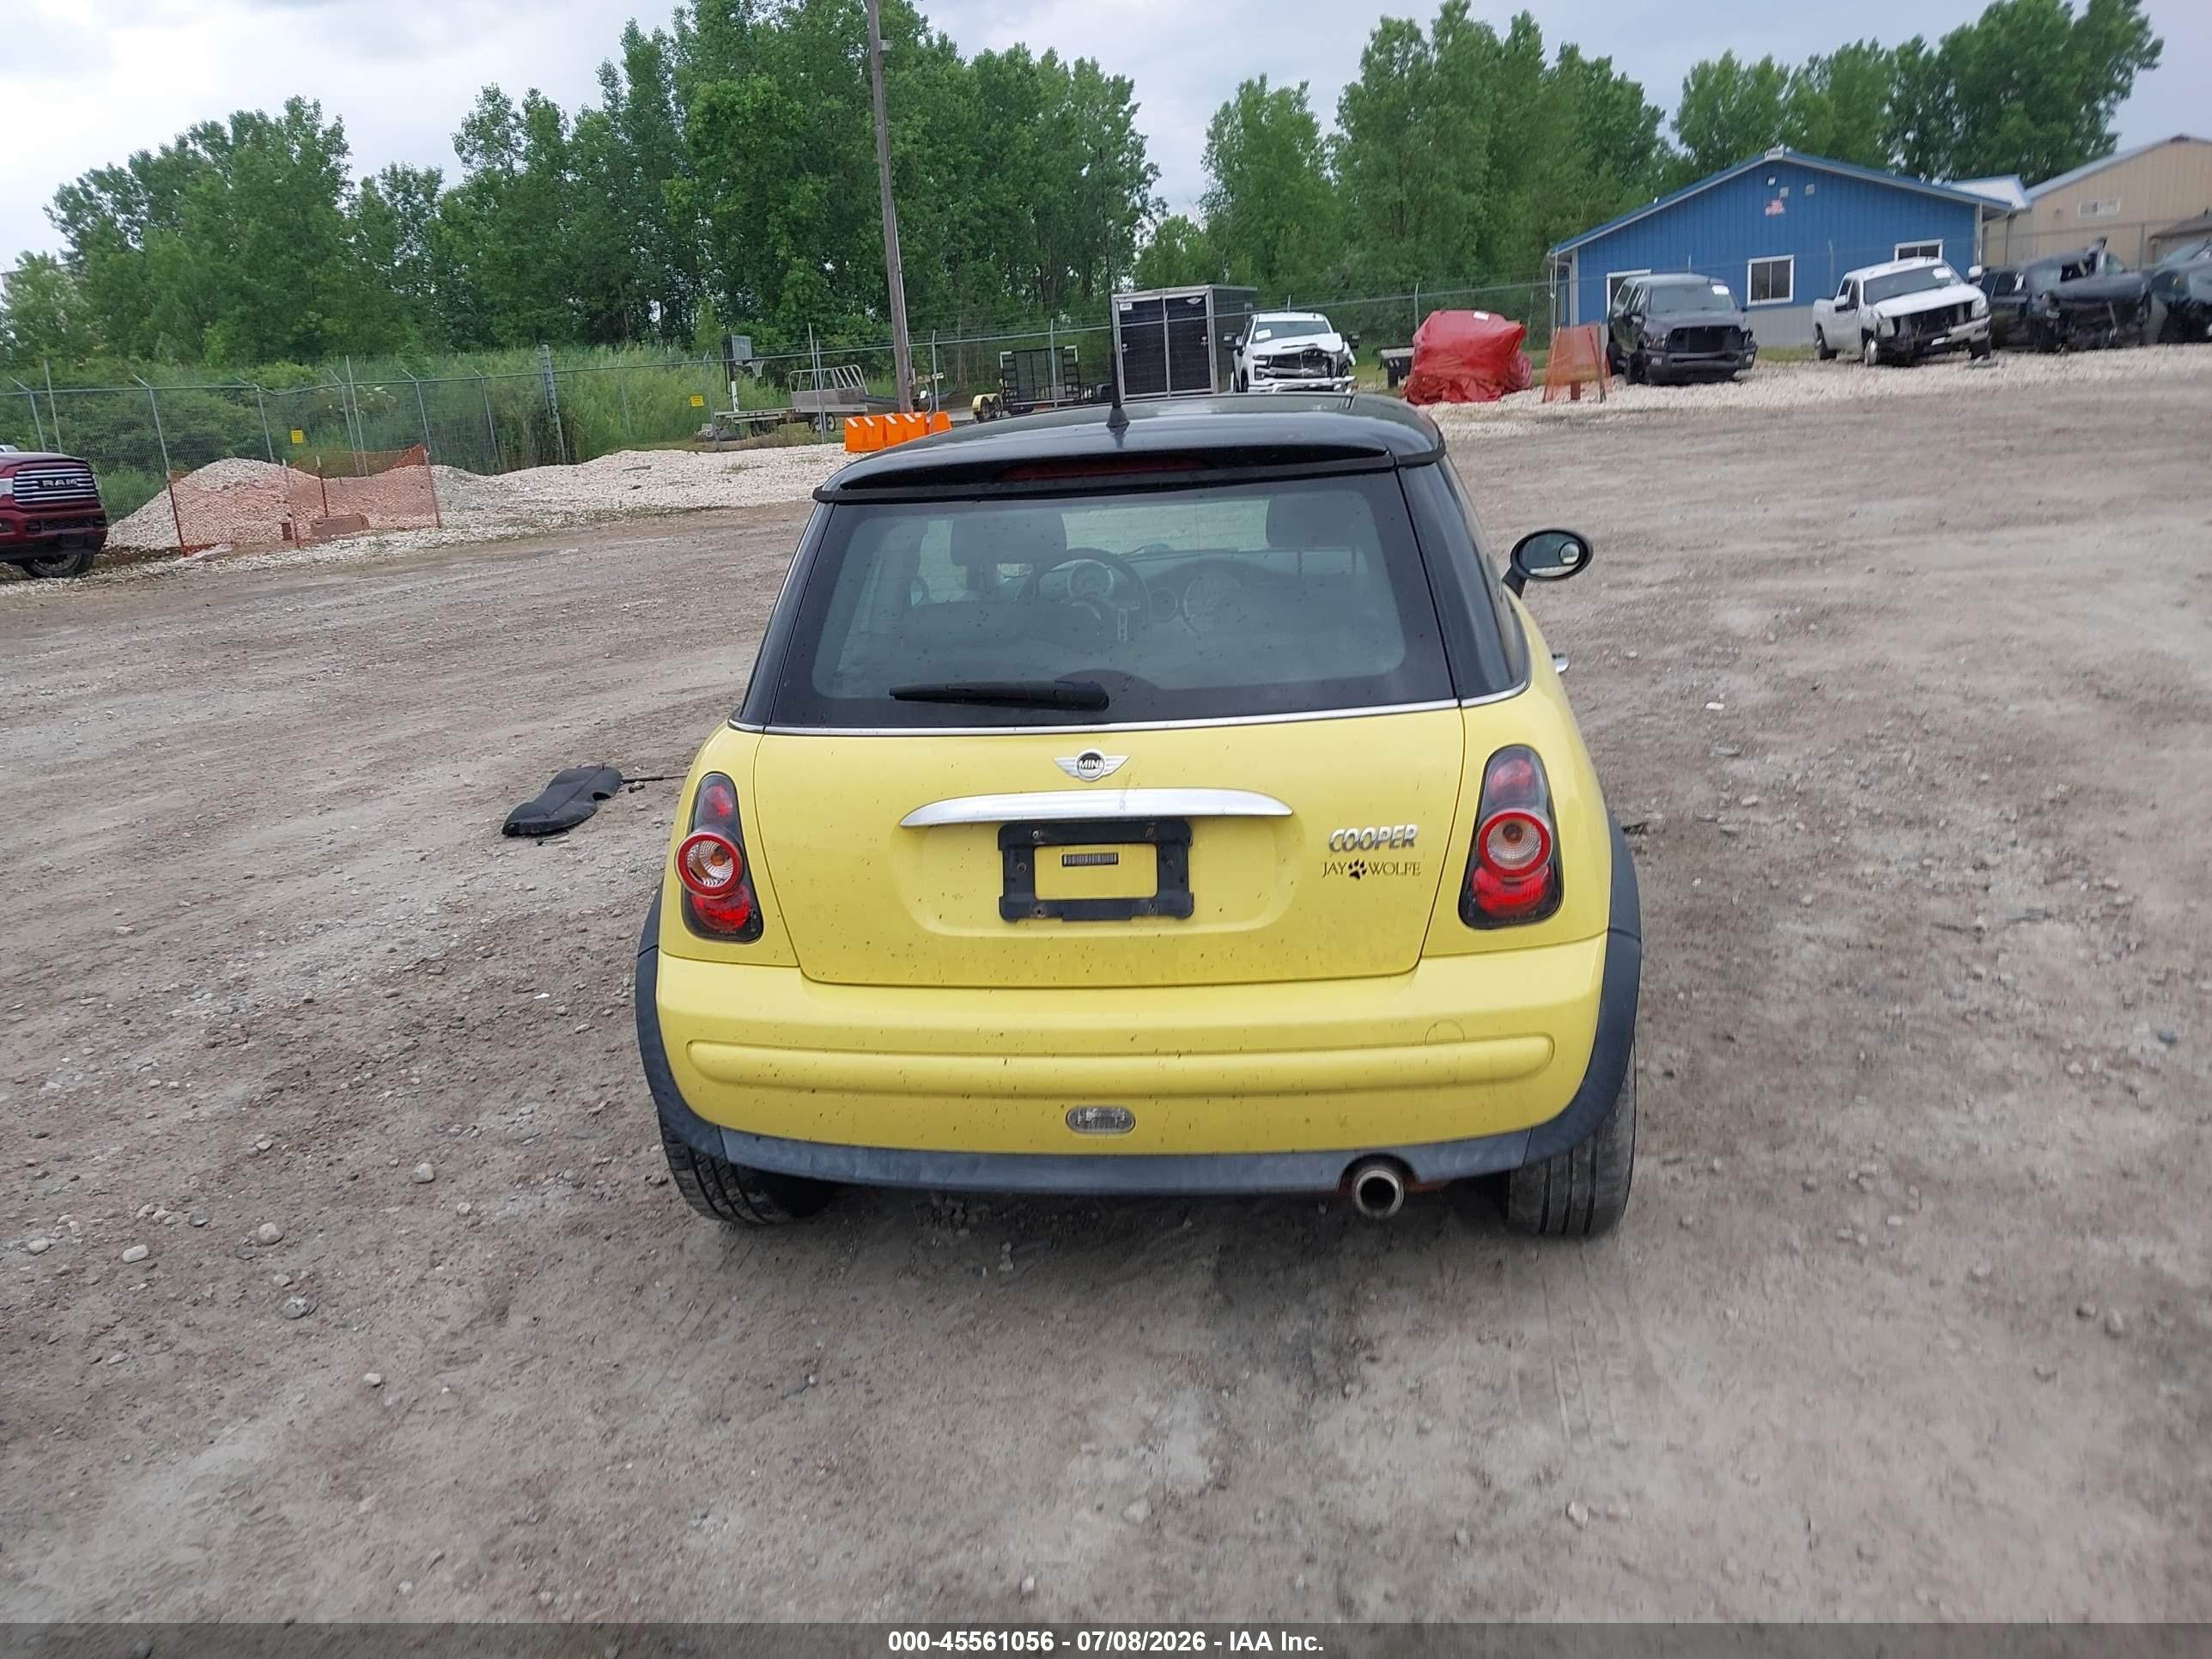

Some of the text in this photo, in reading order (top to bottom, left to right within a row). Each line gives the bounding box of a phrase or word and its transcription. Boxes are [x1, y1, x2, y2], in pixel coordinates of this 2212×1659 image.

[42, 478, 78, 487] RAM
[1079, 759, 1104, 770] MINI
[1328, 823, 1419, 853] COOPER
[1321, 860, 1422, 878] JAY WOLFE
